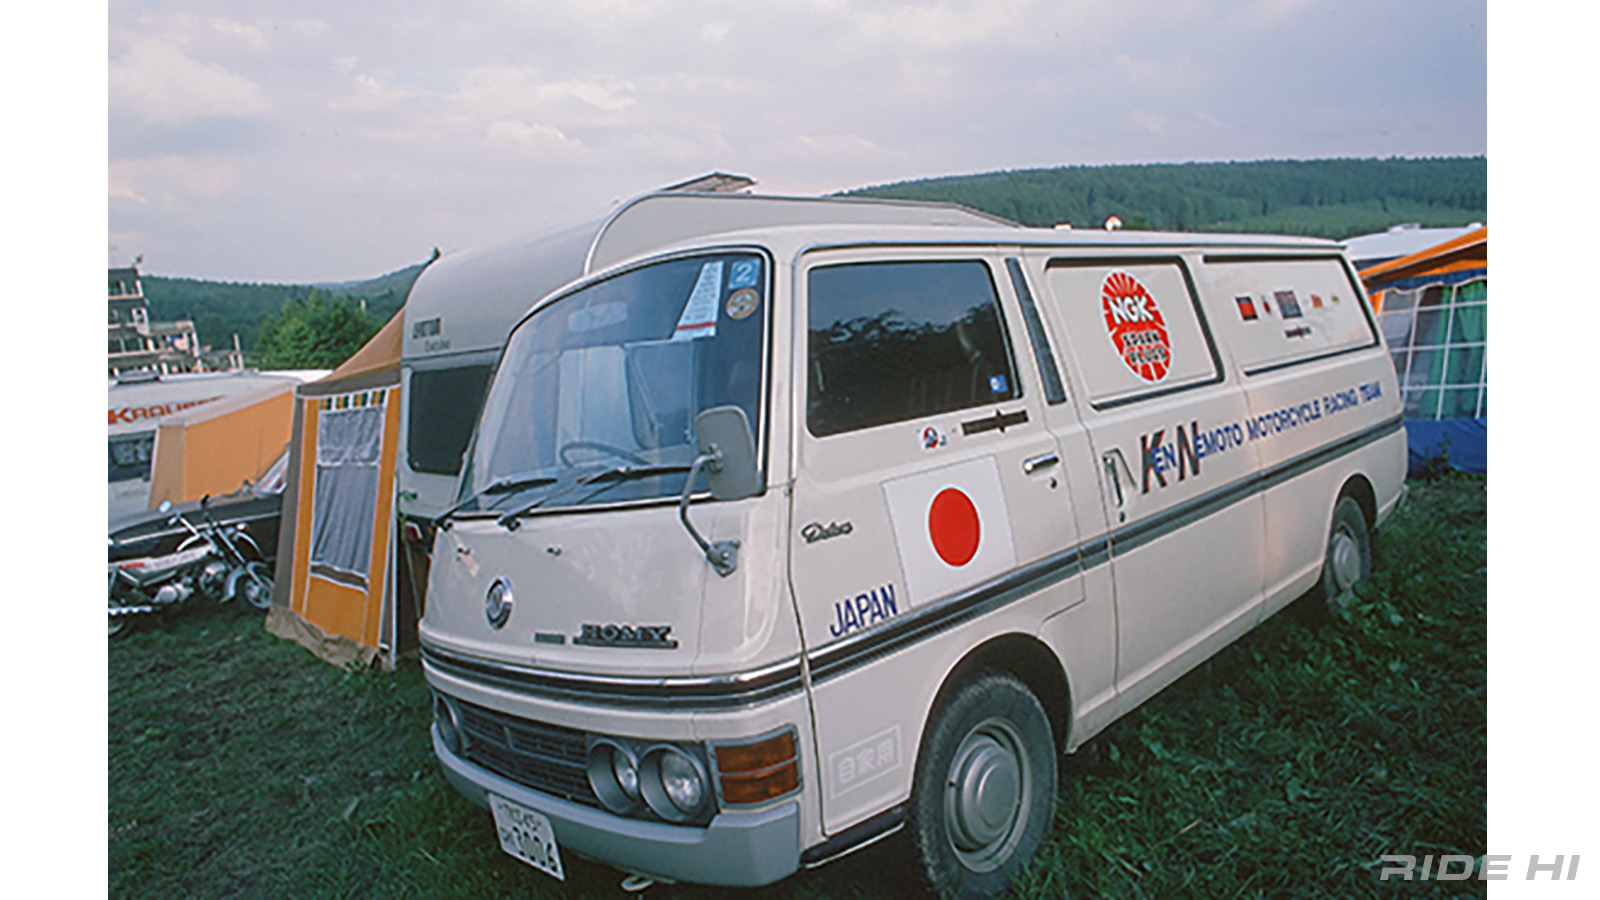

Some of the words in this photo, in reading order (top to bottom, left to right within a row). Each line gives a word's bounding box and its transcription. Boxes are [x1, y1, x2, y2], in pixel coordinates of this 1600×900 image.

[735, 263, 753, 283] 2
[1107, 294, 1154, 325] NGK
[1141, 429, 1177, 495] KEN
[1176, 421, 1243, 482] NEMOTO
[1245, 399, 1321, 438] MOTORCYCLE
[1323, 389, 1358, 415] RACING
[1359, 380, 1383, 403] TEAM
[829, 583, 898, 638] JAPAN
[580, 622, 673, 643] HOMY
[838, 737, 895, 784] 自家用
